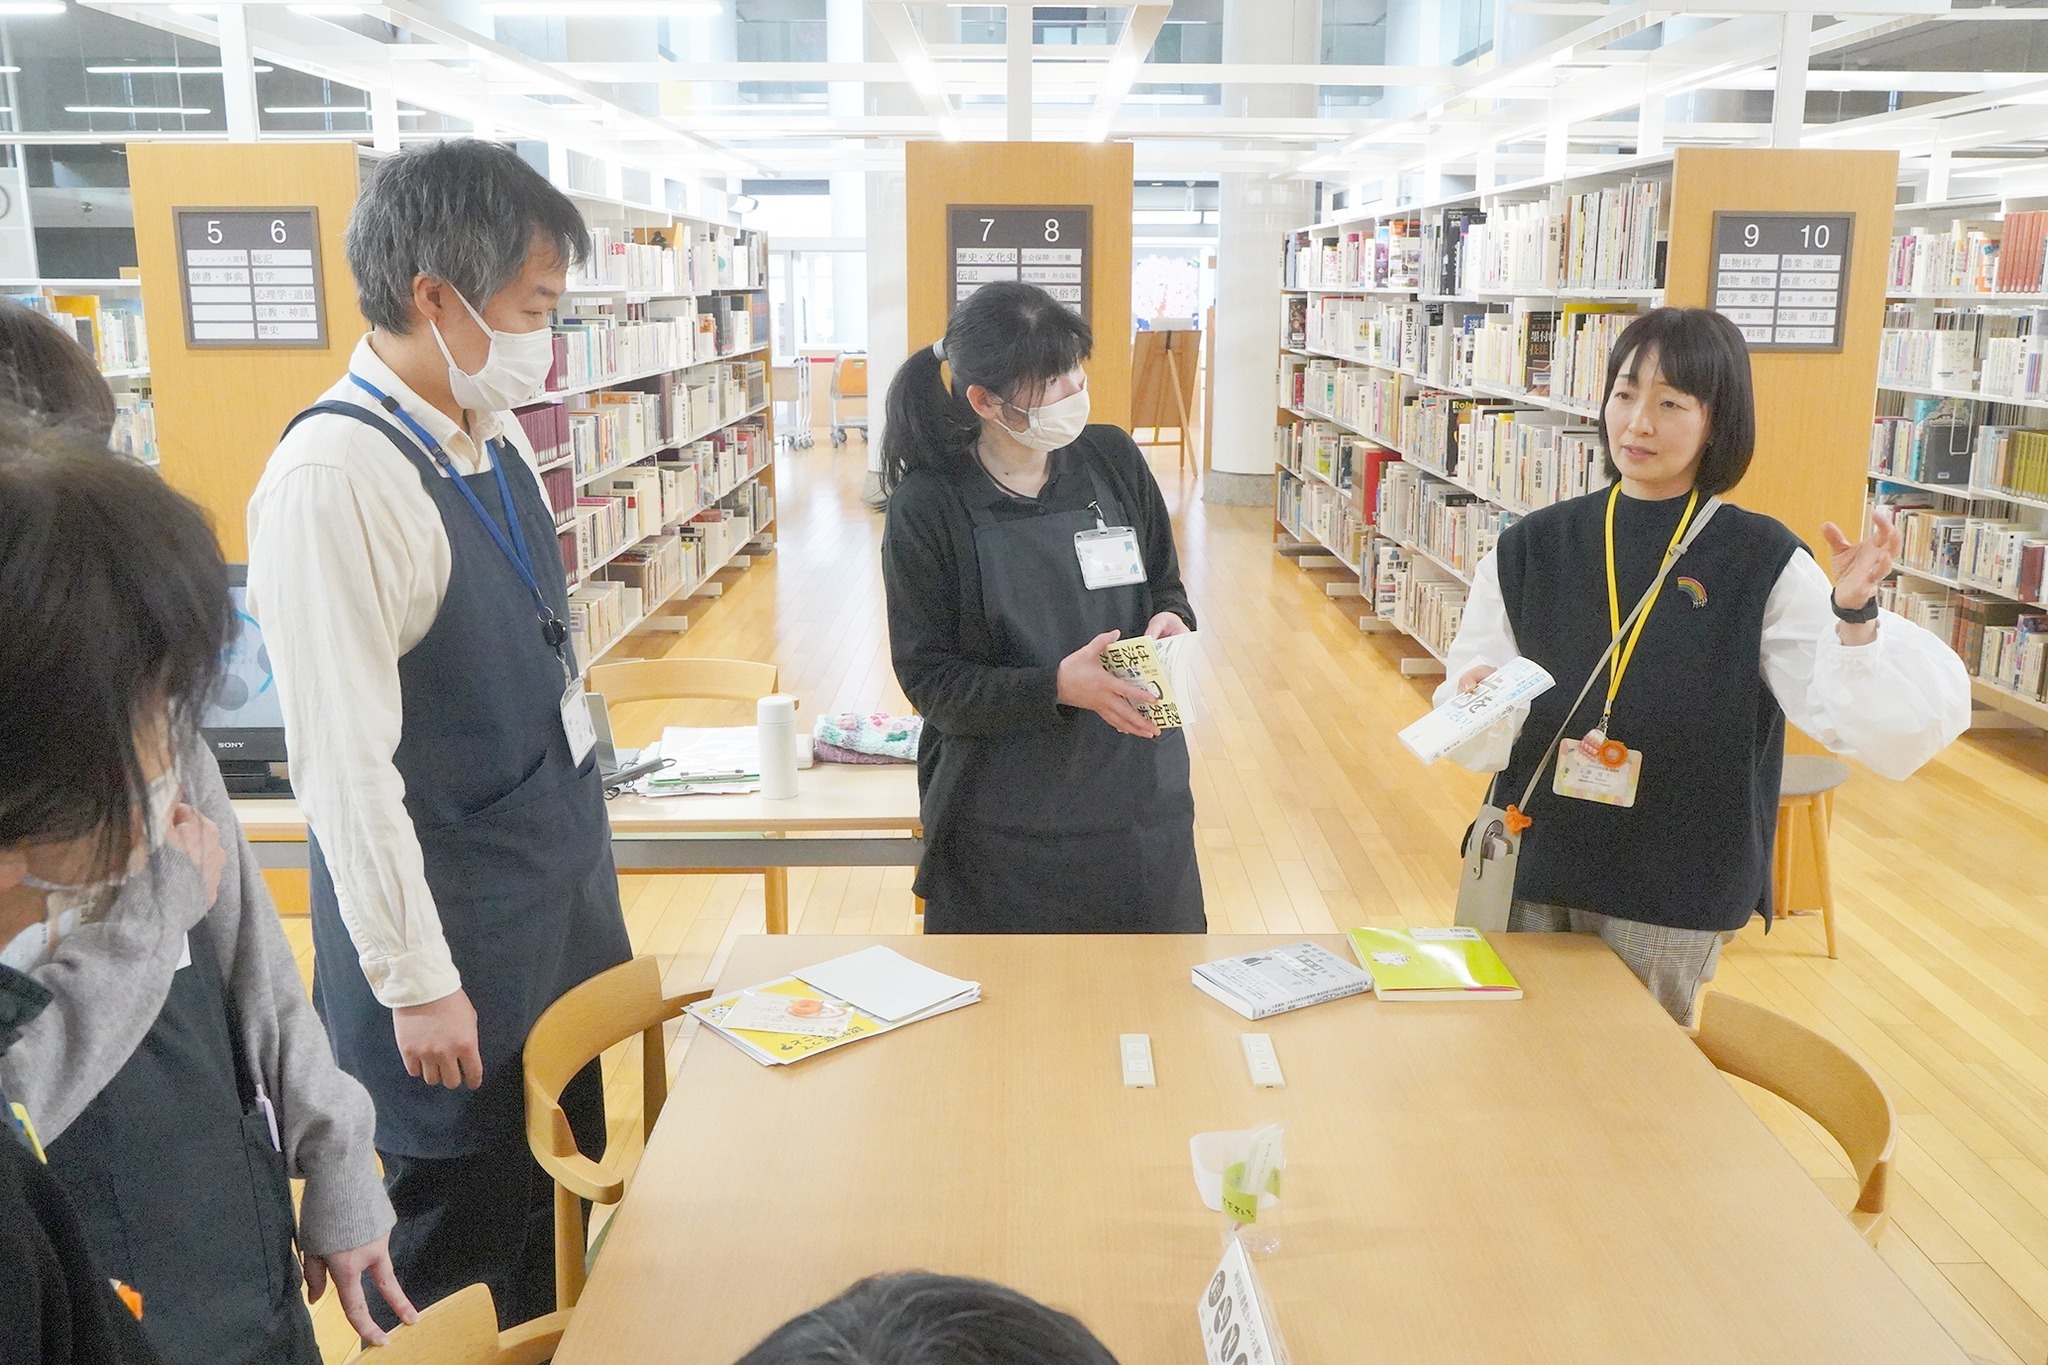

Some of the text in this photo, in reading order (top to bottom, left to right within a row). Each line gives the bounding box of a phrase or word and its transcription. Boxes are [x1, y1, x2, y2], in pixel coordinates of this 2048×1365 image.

[207, 220, 223, 244] 5
[270, 219, 287, 244] 6
[979, 218, 995, 242] 7
[1044, 218, 1060, 243] 8
[1744, 223, 1760, 247] 9
[1800, 224, 1830, 248] 10
[252, 253, 274, 264] 総記
[957, 252, 1016, 263] 歴史・文化史
[1721, 258, 1762, 269] 生物科学
[1782, 258, 1834, 269] 農業・園芸
[191, 271, 244, 283] 辞書・事典
[254, 271, 275, 282] 哲学
[957, 270, 978, 280] 伝記
[1719, 275, 1771, 286] 動物・植物
[257, 307, 310, 318] 宗教・神話
[1779, 311, 1829, 322] 絵画・書道
[259, 325, 280, 336] 歴史
